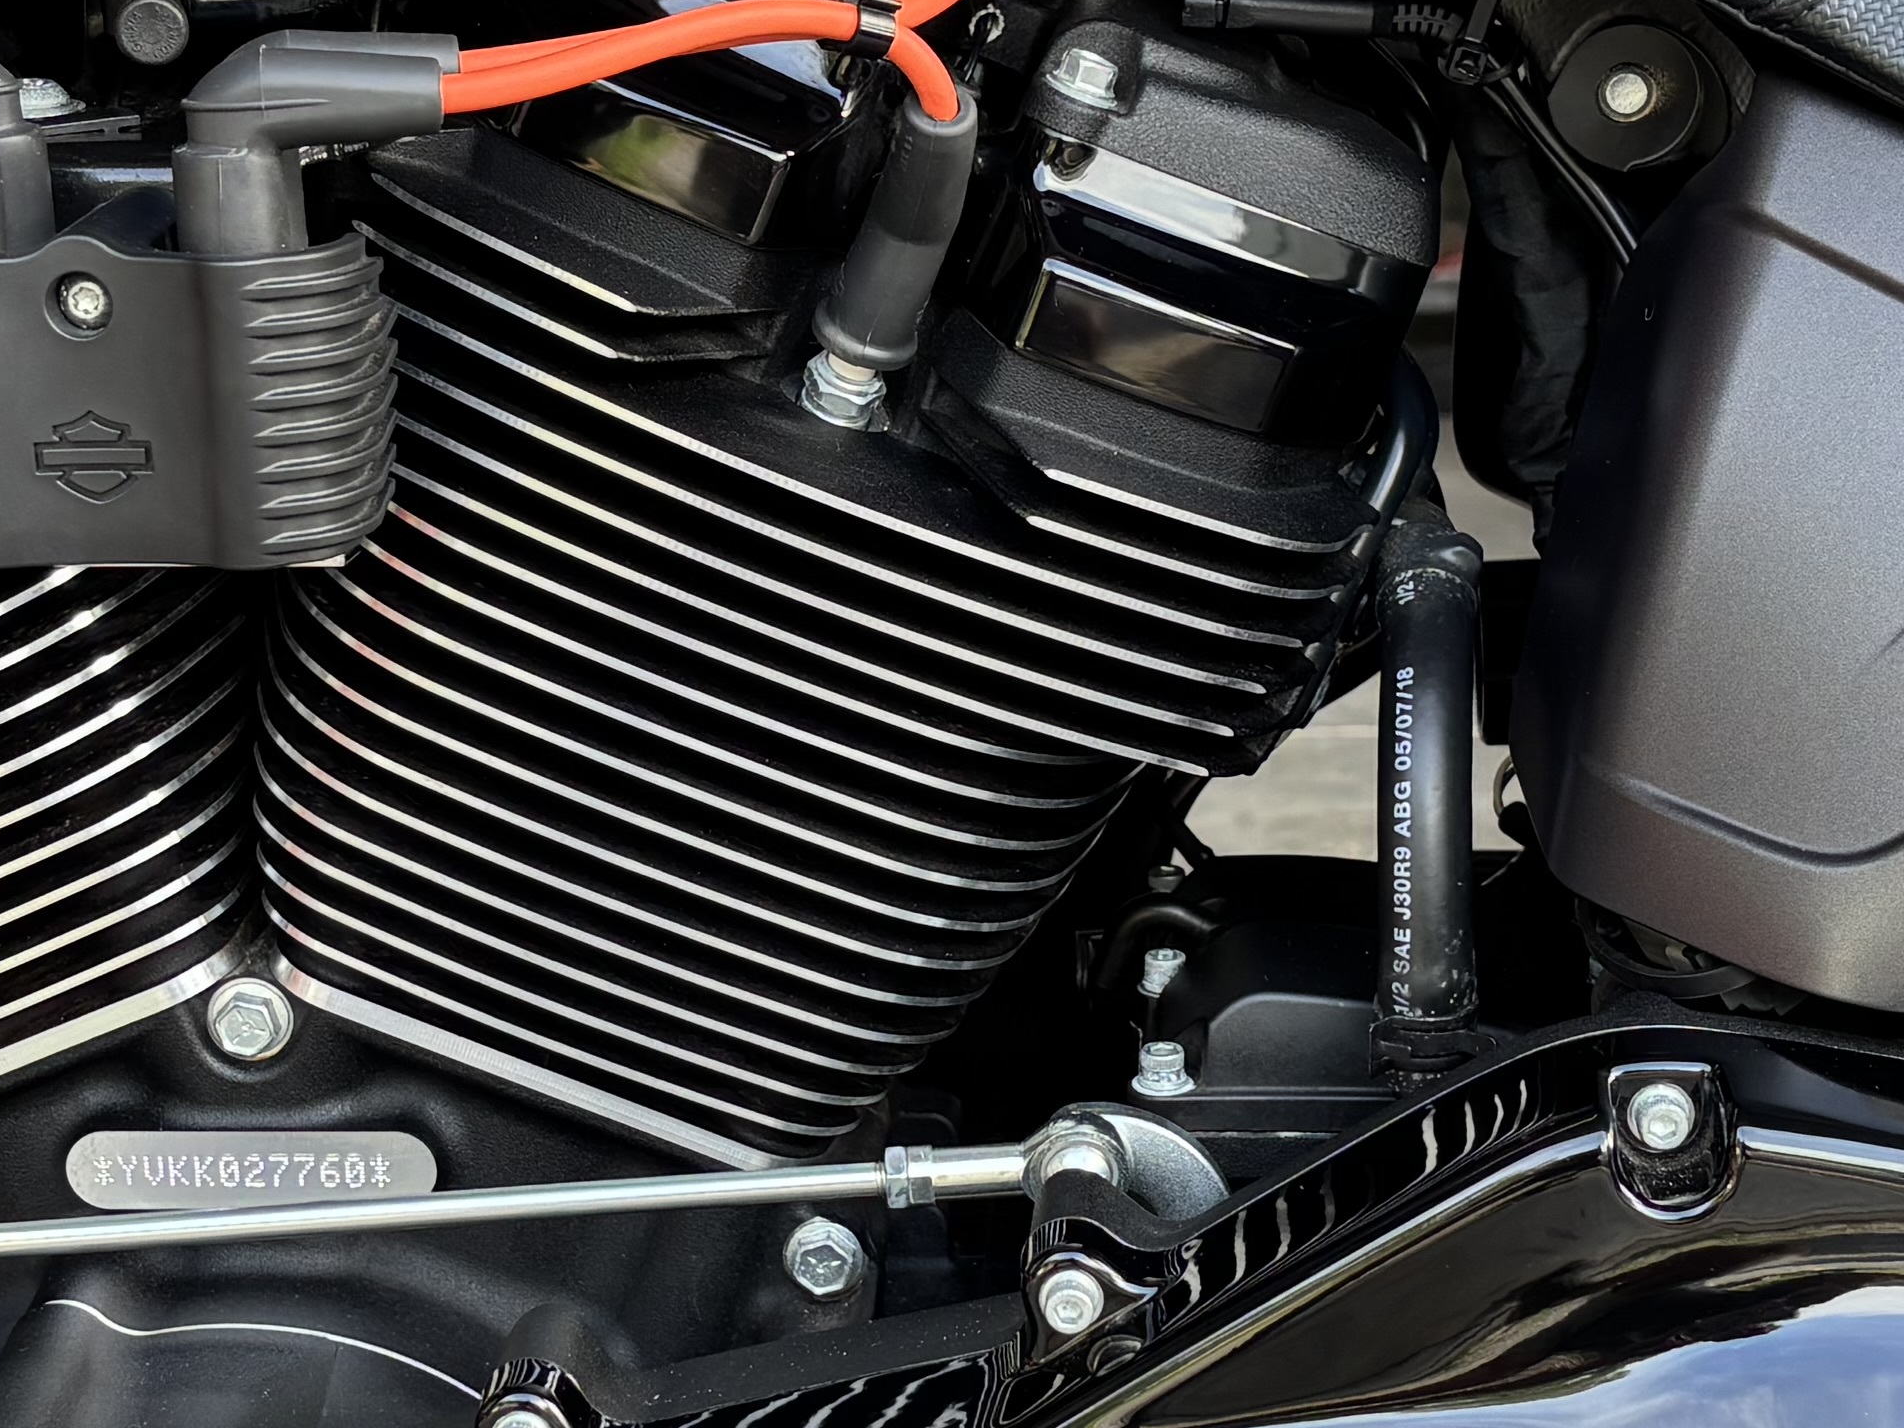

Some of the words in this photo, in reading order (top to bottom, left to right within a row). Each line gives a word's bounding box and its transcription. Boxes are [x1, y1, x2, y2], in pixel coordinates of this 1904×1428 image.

[1394, 666, 1415, 772] 05/07/18
[1393, 780, 1413, 839] ABG
[1393, 846, 1413, 921] J30R9
[1393, 927, 1412, 975] SAE
